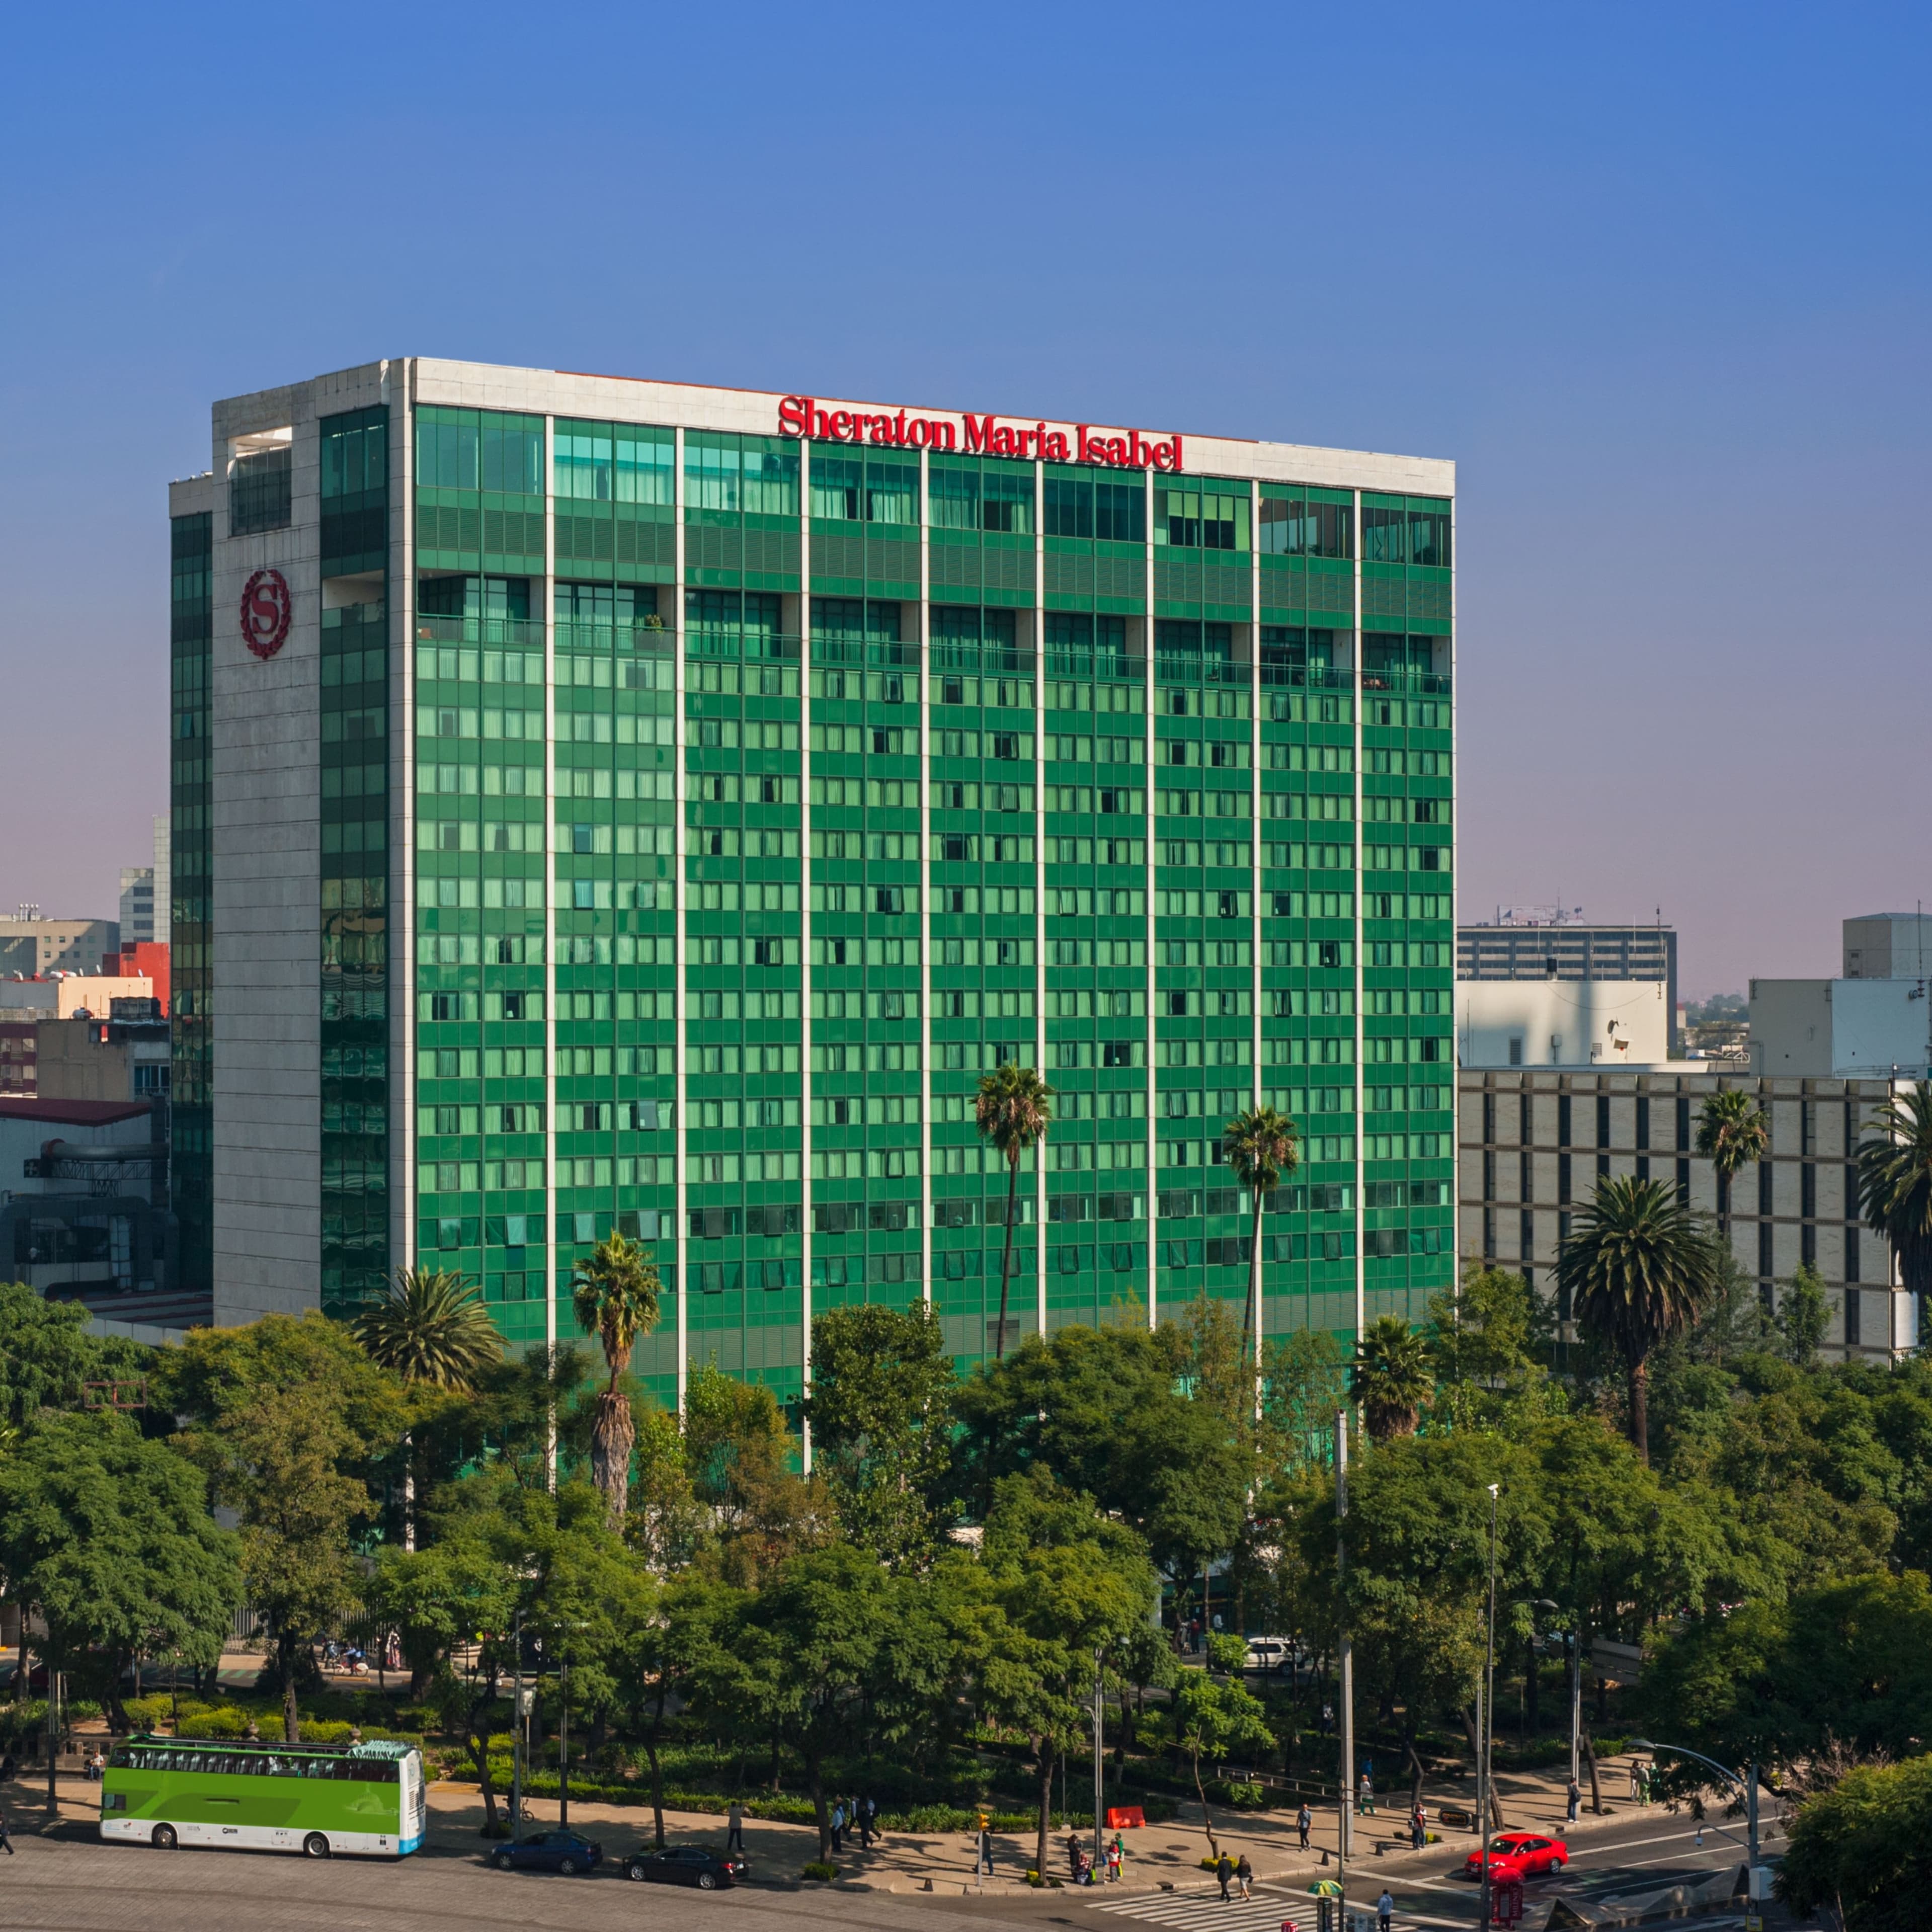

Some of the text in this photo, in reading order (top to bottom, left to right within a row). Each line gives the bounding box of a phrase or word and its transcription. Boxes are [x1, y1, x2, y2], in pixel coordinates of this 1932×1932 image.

[779, 395, 1184, 470] Sheraton Maria Isabel
[252, 584, 279, 634] S
